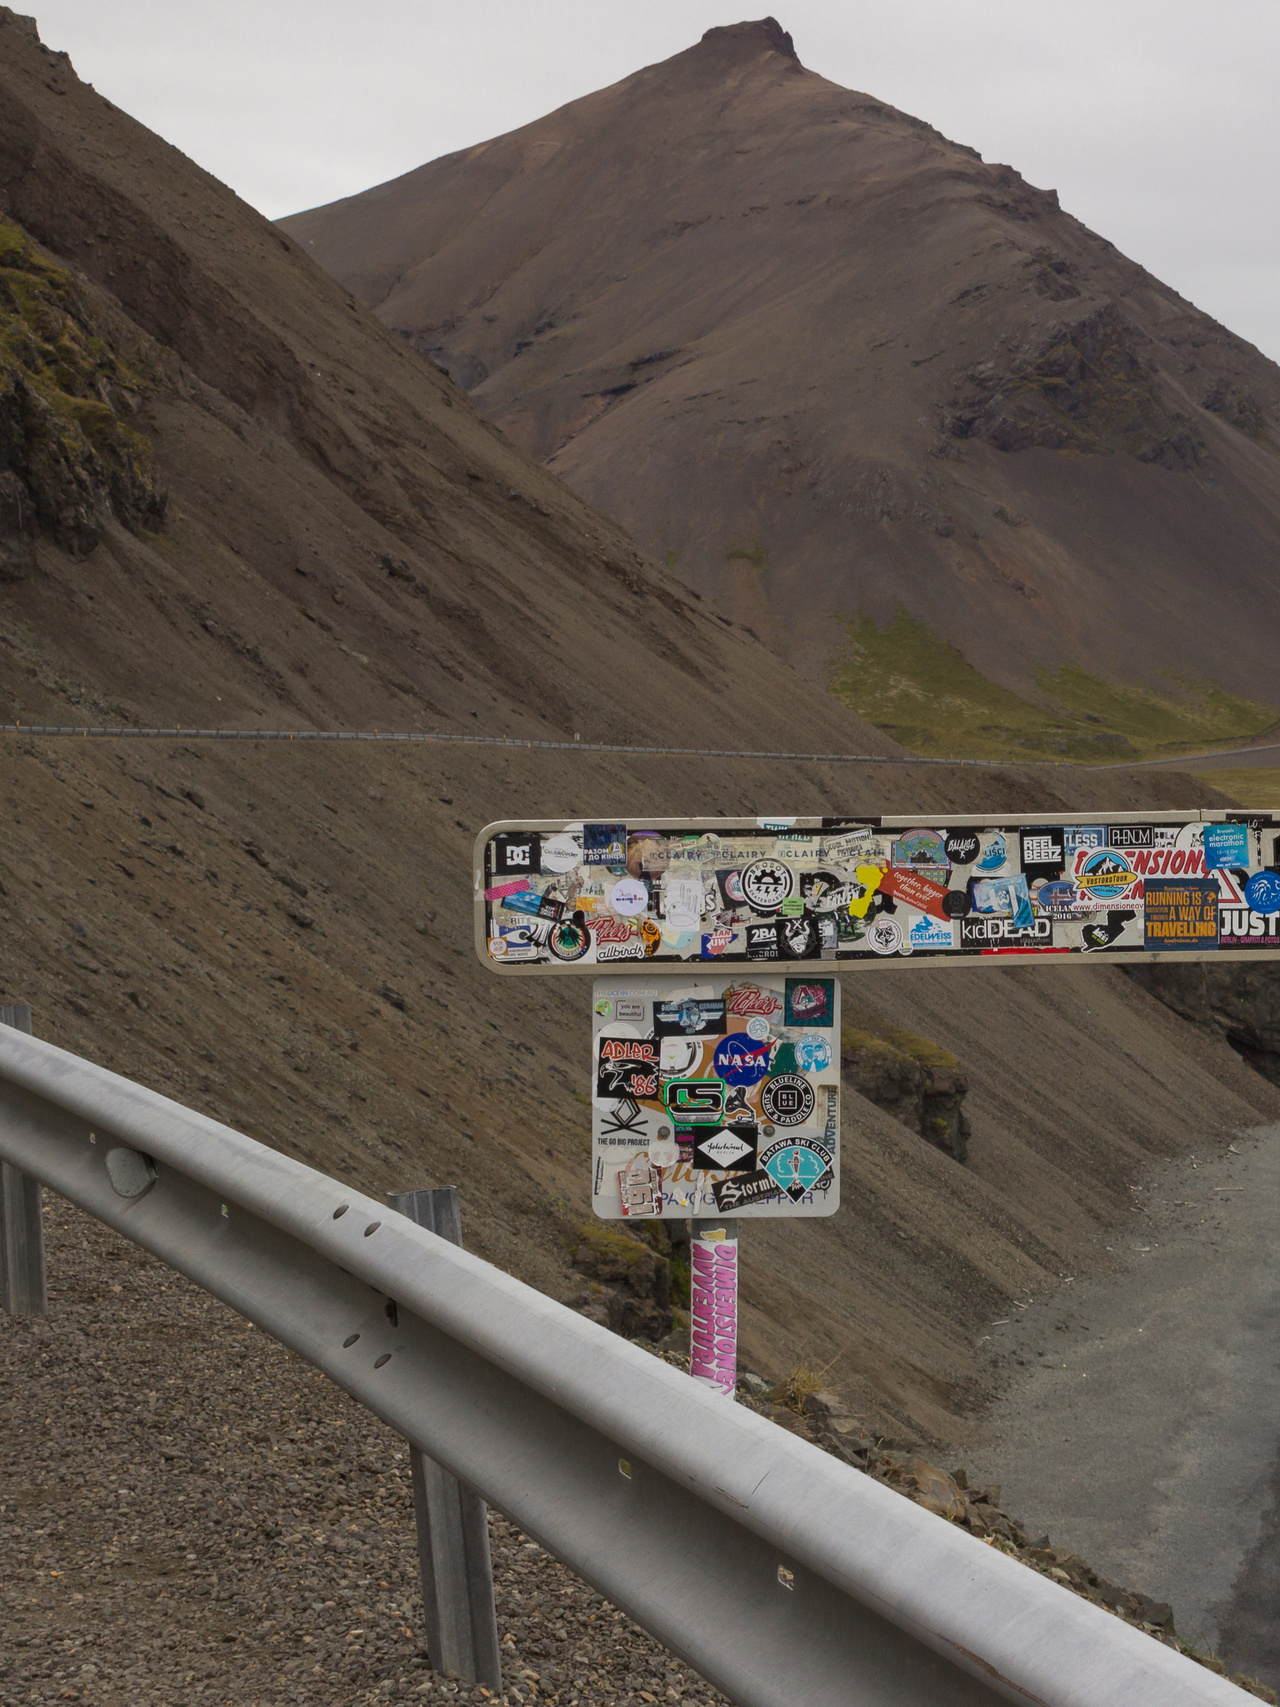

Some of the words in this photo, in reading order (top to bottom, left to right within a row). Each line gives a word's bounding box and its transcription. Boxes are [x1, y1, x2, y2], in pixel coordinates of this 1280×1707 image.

[1024, 839, 1053, 850] REEL
[1209, 833, 1244, 842] electronic
[1209, 840, 1244, 848] marathon
[786, 850, 830, 858] CLAIRY
[1024, 849, 1062, 860] BEETZ
[750, 862, 787, 875] BROBOT
[899, 883, 916, 895] than
[915, 892, 931, 902] ever
[923, 884, 944, 899] bigger
[1146, 892, 1190, 906] RUNNING
[1192, 892, 1202, 906] IS
[1053, 912, 1072, 920] 2016
[1169, 906, 1176, 920] A
[1179, 906, 1201, 920] WAY
[1203, 906, 1216, 920] OF
[1146, 921, 1217, 937] TRAVELLING
[1221, 910, 1280, 936] JUST
[910, 932, 952, 940] EDELWEISS
[599, 944, 643, 958] allbirds
[601, 1040, 660, 1061] ADLER
[718, 1053, 767, 1067] NASA
[769, 1076, 807, 1090] BLUELINE
[764, 1093, 774, 1114] SURF
[780, 1105, 810, 1124] PADDLE
[827, 1086, 838, 1155] ADVENTURE
[609, 1138, 617, 1146] GO
[617, 1138, 627, 1146] BIG
[627, 1138, 650, 1146] PROJECT
[762, 1139, 793, 1162] BATAWA
[795, 1138, 810, 1147] SKI
[811, 1140, 831, 1162] CLUB
[692, 1242, 716, 1379] AVVENTURA
[714, 1244, 737, 1386] DIMENSIONE
